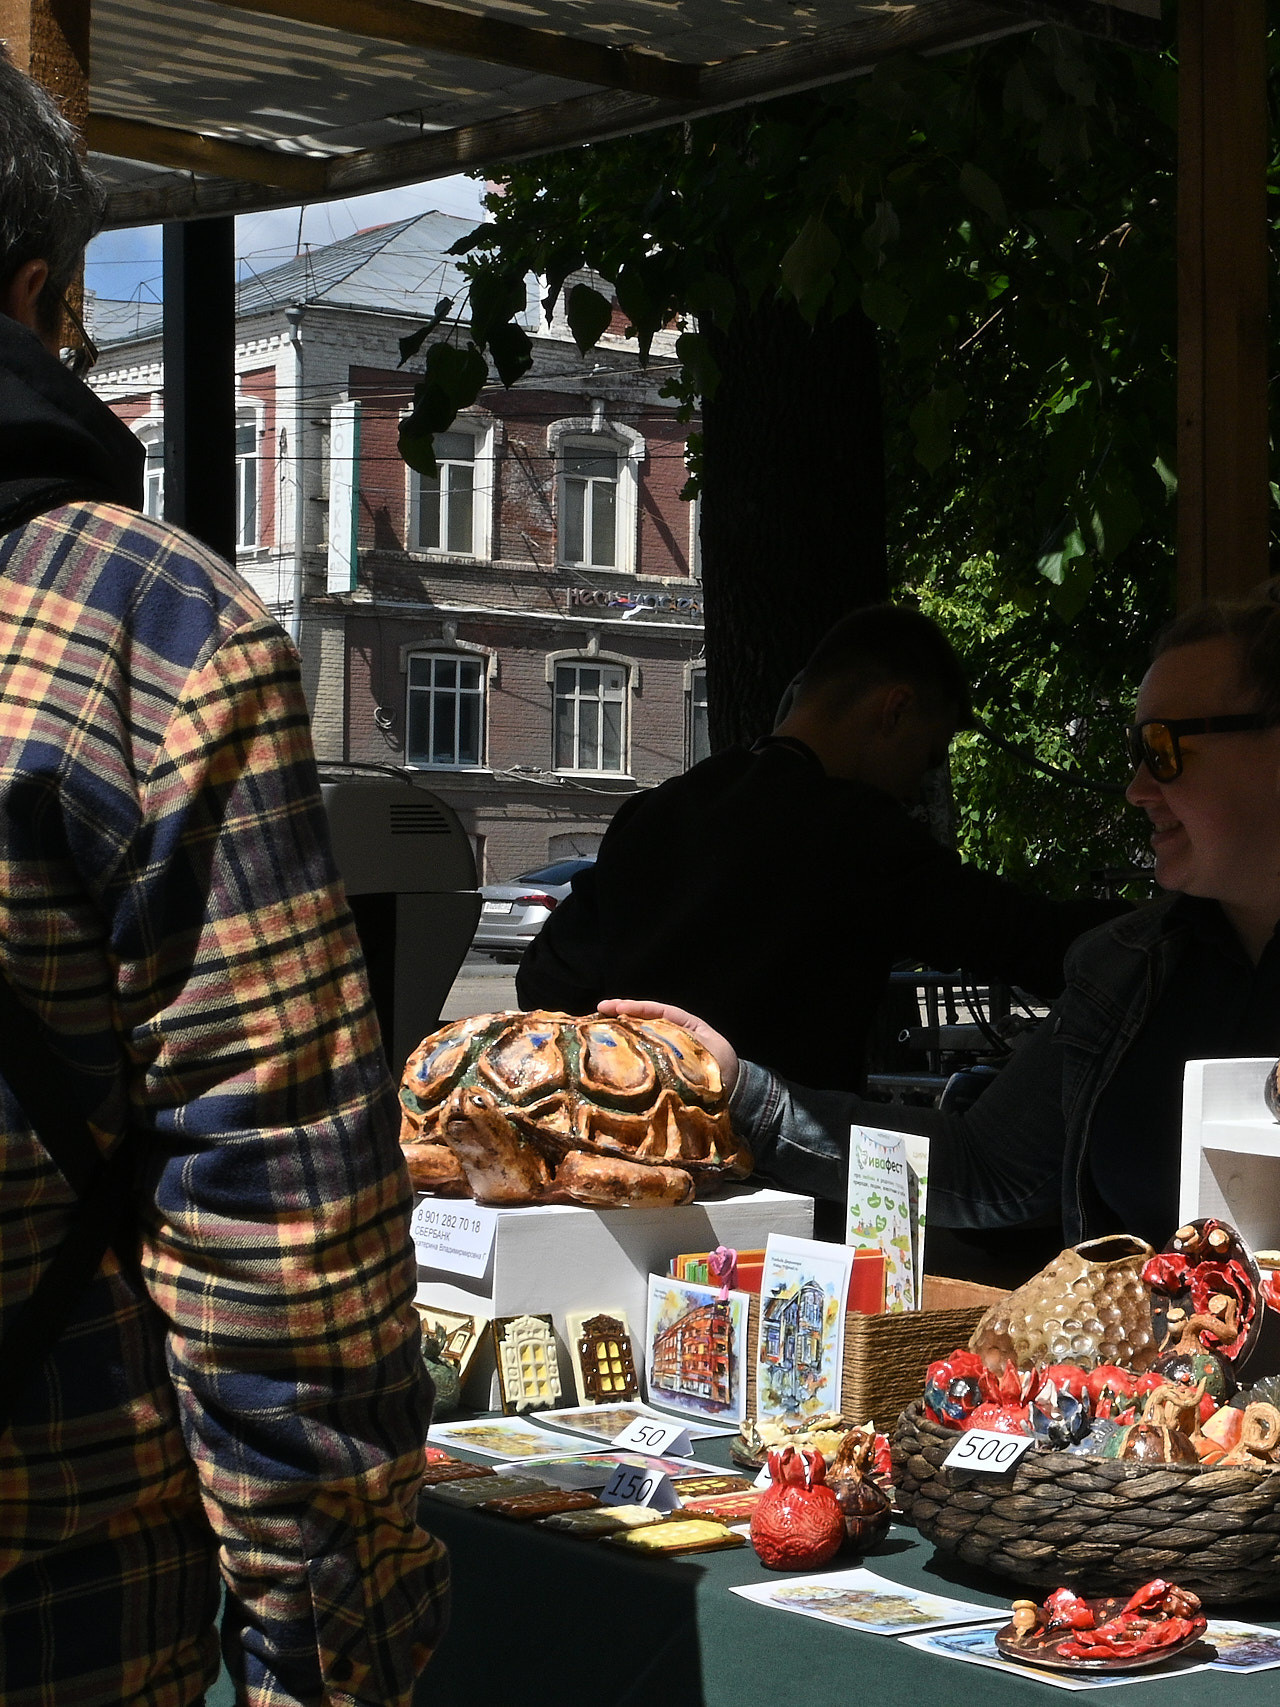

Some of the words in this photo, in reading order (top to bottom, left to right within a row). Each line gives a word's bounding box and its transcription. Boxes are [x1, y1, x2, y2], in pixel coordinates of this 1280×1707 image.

[414, 1225, 451, 1241] СБЕРБАНК
[418, 1209, 424, 1221] 8
[425, 1211, 440, 1224] 901
[441, 1214, 457, 1229] 282
[459, 1217, 469, 1231] 70
[472, 1220, 481, 1233] 18
[630, 1425, 666, 1447] 50
[957, 1436, 1019, 1463] 500
[608, 1472, 654, 1502] 150
